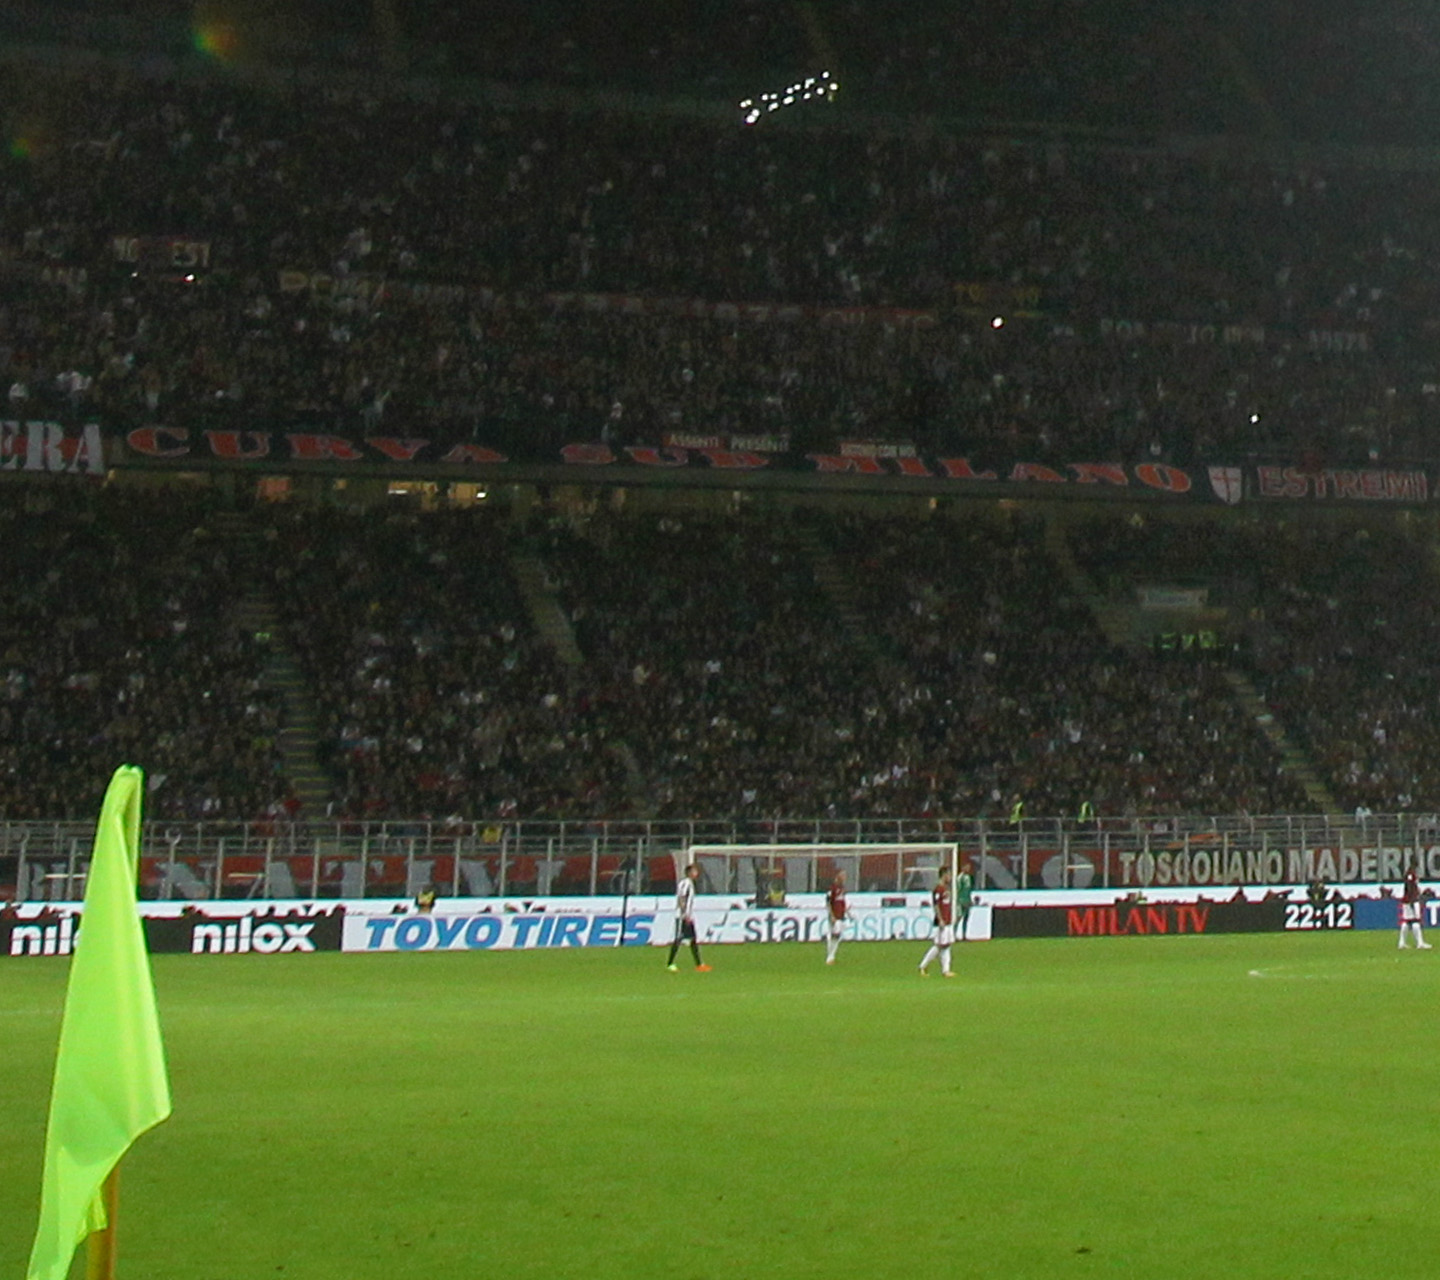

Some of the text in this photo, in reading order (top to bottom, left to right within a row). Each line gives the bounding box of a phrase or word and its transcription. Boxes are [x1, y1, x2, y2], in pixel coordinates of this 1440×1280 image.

[1257, 466, 1428, 502] ESTREMI
[1120, 848, 1283, 885] TOSCOLANO
[365, 913, 655, 950] TOYO TIRES
[1067, 906, 1211, 935] MILAN TV
[1285, 903, 1353, 929] 22:12
[11, 917, 79, 955] nil
[192, 916, 317, 955] nilox
